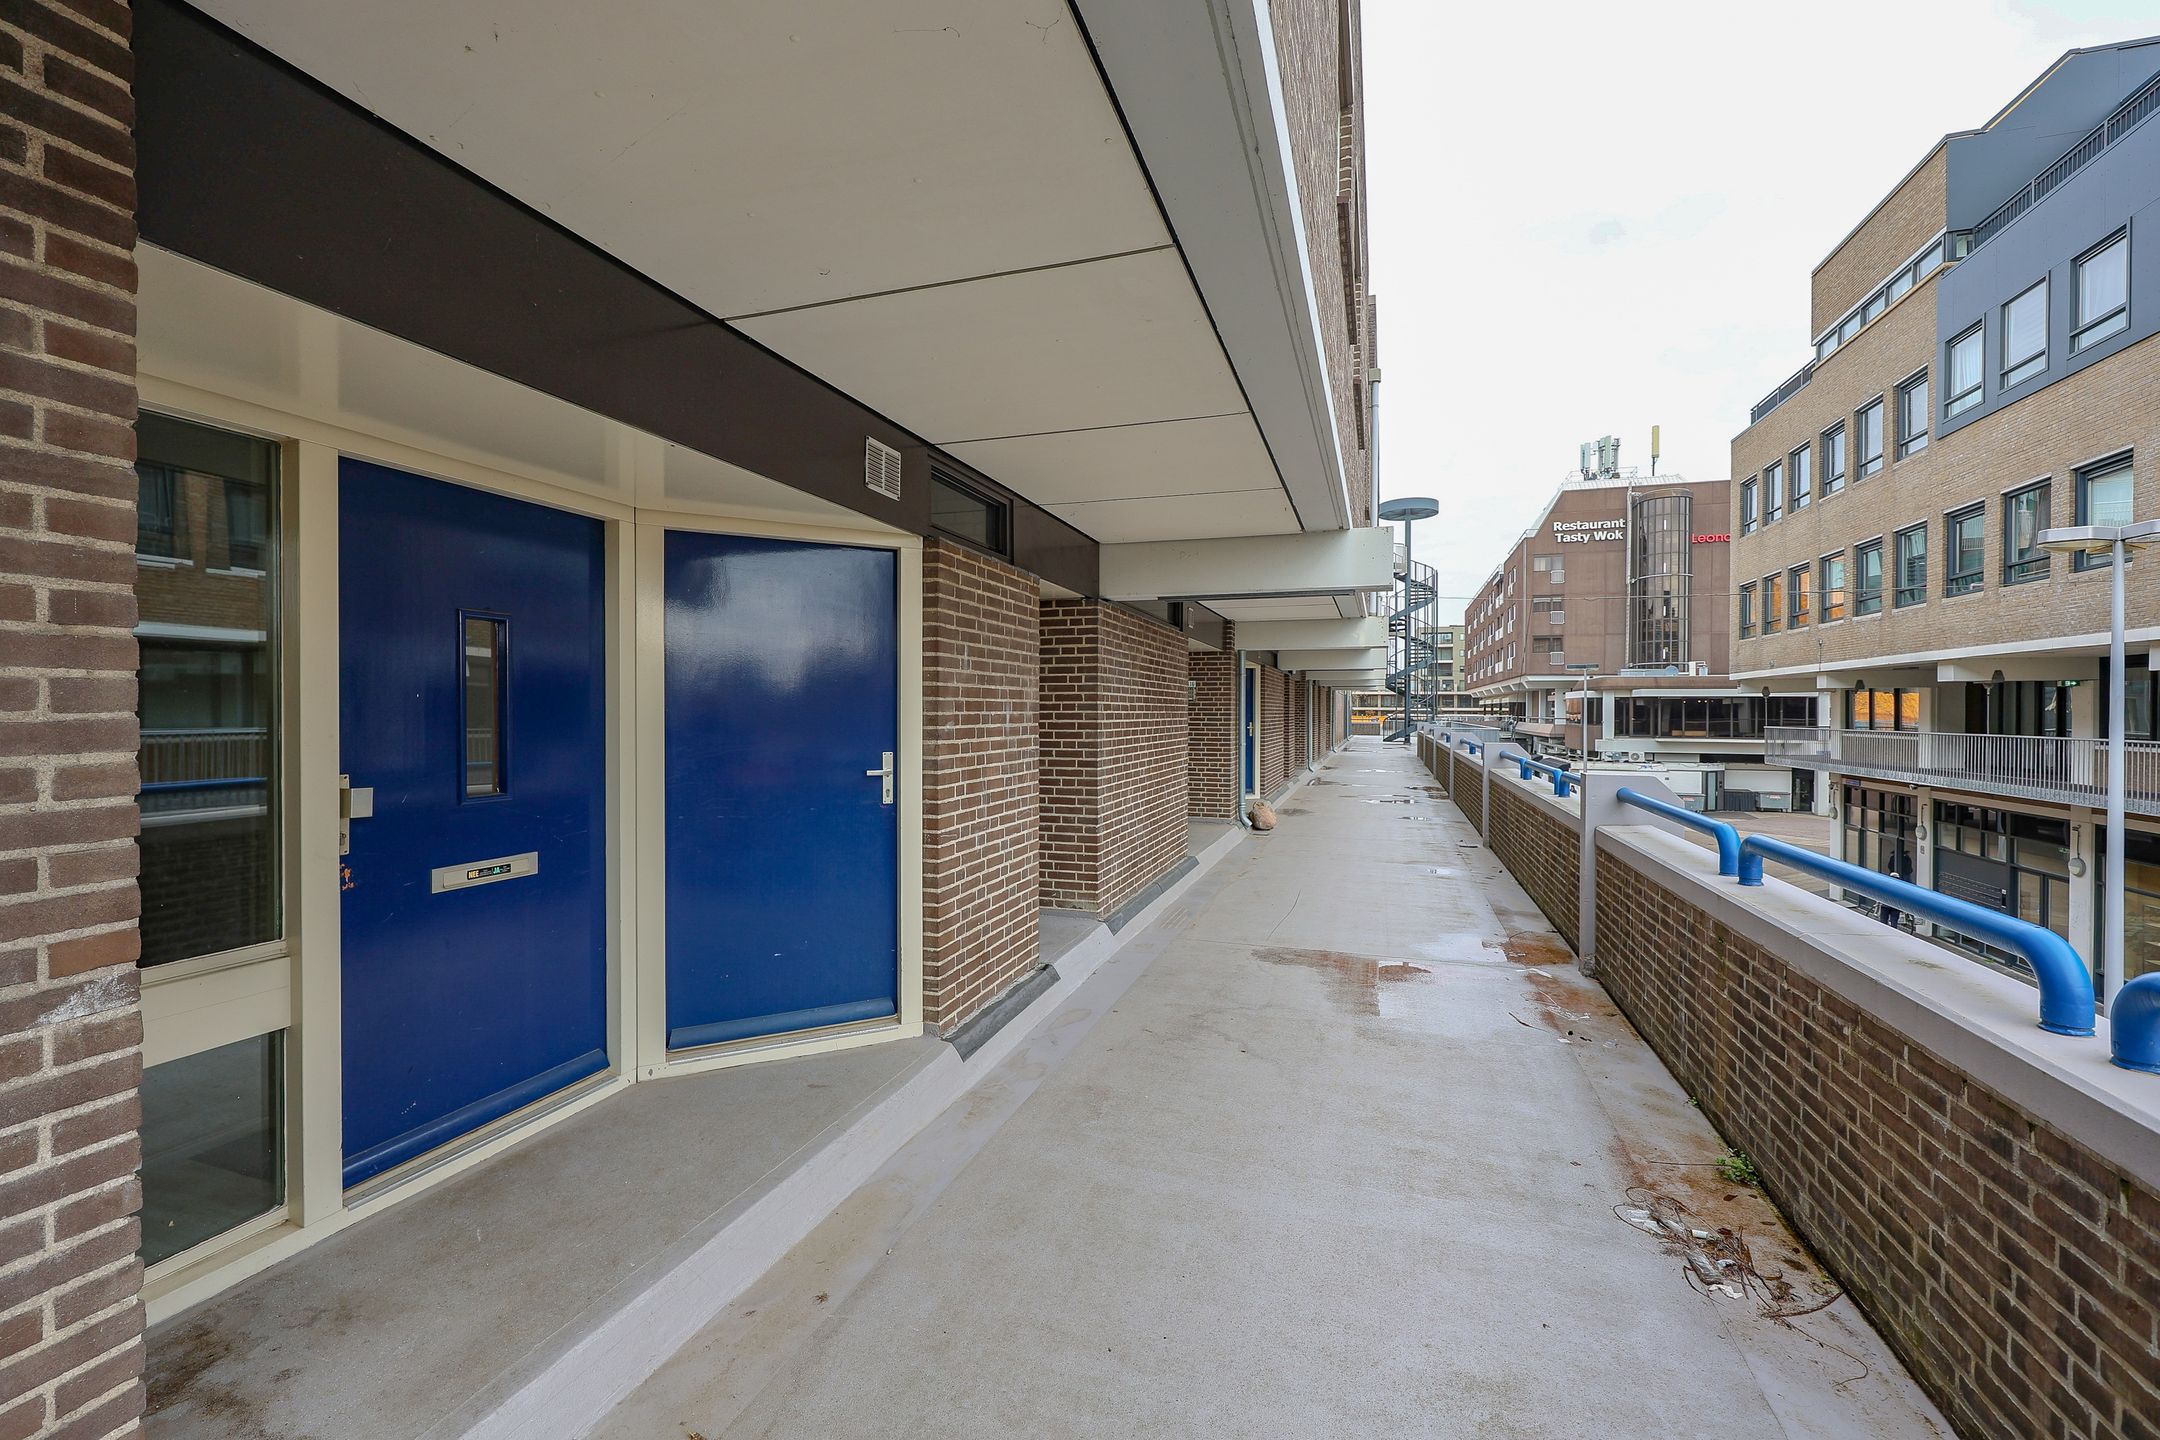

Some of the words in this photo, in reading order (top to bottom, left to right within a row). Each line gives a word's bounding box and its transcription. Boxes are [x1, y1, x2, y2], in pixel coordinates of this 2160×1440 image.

[1553, 518, 1626, 532] Restaurant
[1555, 533, 1591, 545] Tasty
[1593, 530, 1624, 542] Wok
[468, 870, 479, 879] NEE
